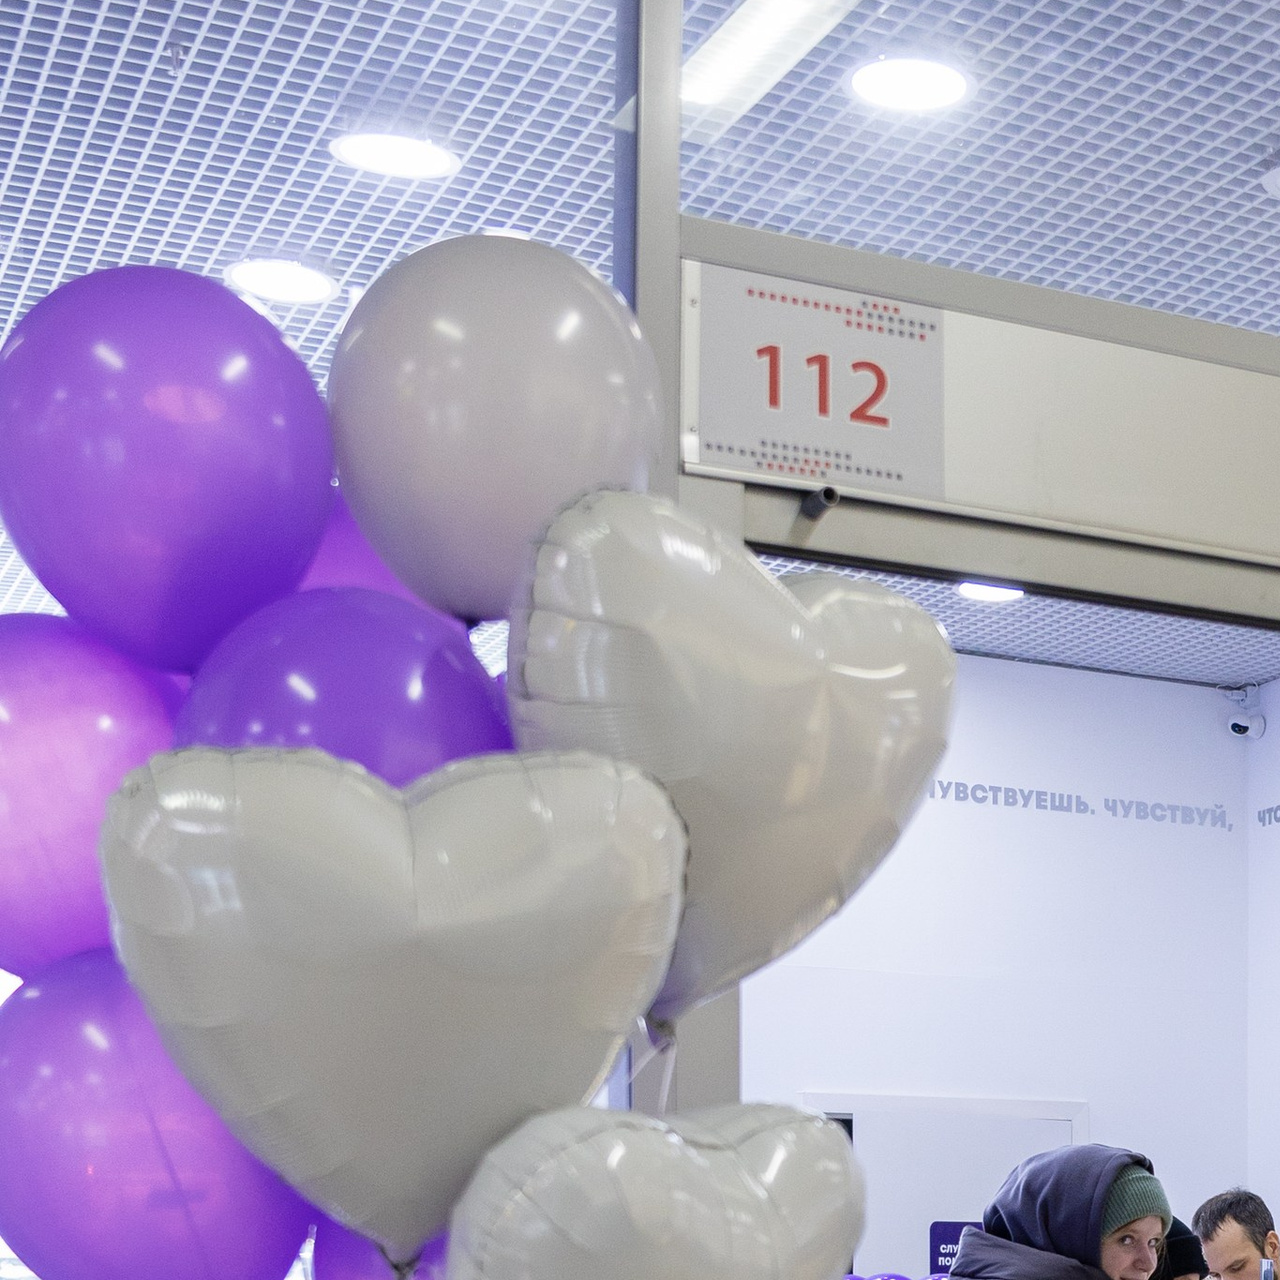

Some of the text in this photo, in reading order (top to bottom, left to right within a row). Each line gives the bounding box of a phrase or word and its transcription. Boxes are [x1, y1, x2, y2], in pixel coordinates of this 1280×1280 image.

[756, 345, 891, 429] 112
[1103, 798, 1234, 832] ЧУВСТВУЙ,
[939, 1244, 959, 1254] СЛУ
